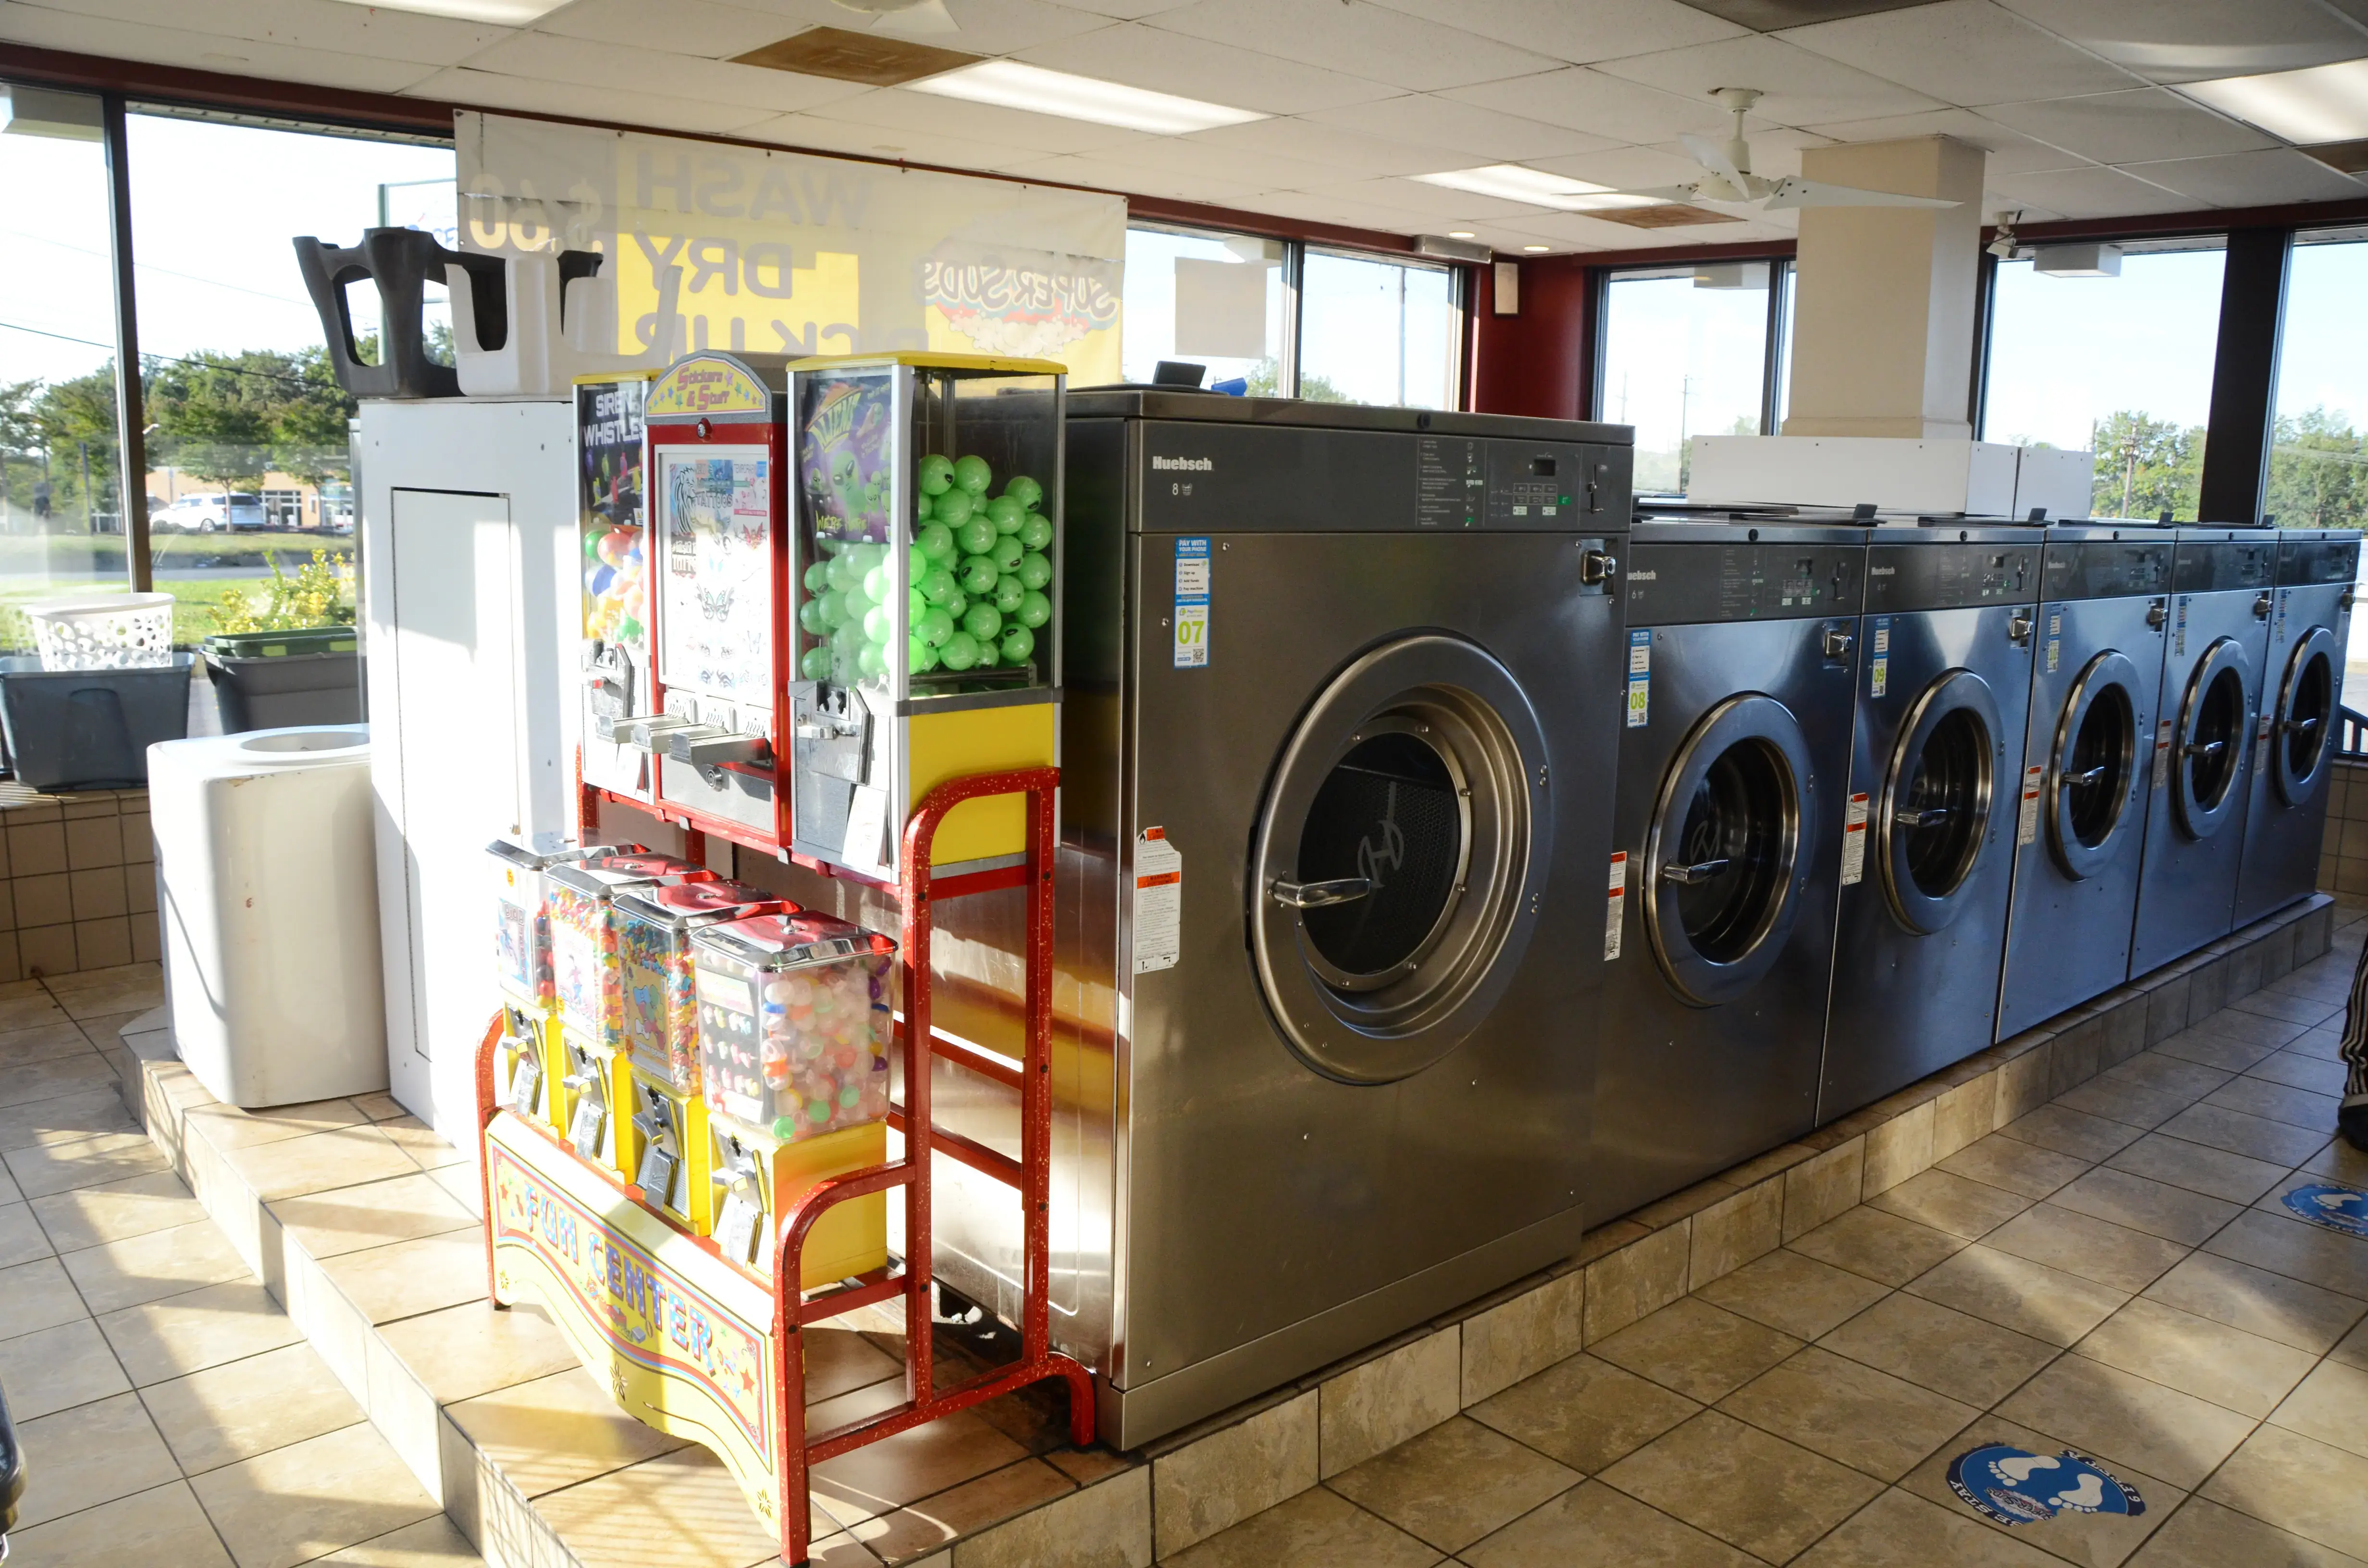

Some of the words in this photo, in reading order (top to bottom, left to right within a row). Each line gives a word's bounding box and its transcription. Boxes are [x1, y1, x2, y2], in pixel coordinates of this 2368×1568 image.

[596, 390, 632, 417] SIREN
[1152, 455, 1212, 470] Huebsch
[1172, 483, 1179, 495] 8
[1628, 570, 1656, 580] uebsch
[1632, 590, 1637, 599] 6
[1178, 621, 1204, 644] 07
[1874, 668, 1885, 683] 09
[1630, 692, 1645, 710] 08
[524, 1180, 579, 1265] FUN
[589, 1231, 716, 1377] CENTER
[1949, 1480, 1993, 1514] STAY
